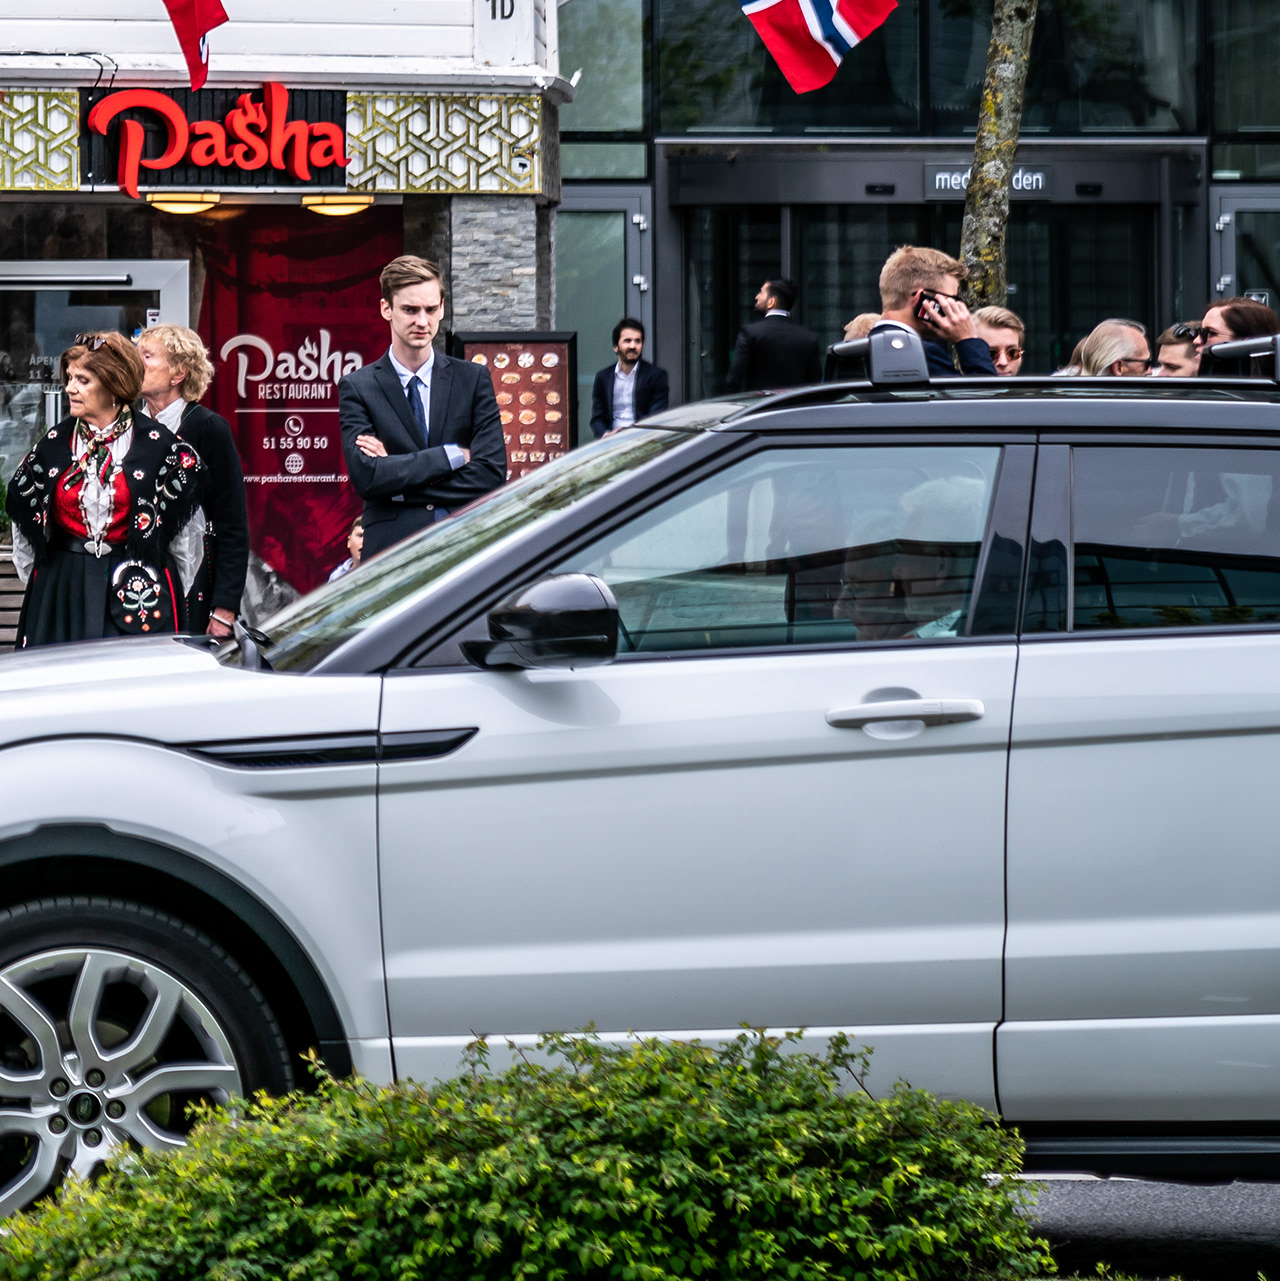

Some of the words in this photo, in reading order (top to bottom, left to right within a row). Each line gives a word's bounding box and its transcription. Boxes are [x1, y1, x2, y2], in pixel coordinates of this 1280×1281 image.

[87, 82, 352, 199] Pasha
[935, 168, 1043, 191] medden
[220, 328, 364, 399] Pasha
[258, 383, 333, 400] RESTAURANT
[262, 437, 276, 449] 51
[279, 437, 294, 449] 55
[296, 437, 311, 449] 90
[313, 437, 329, 449] 50
